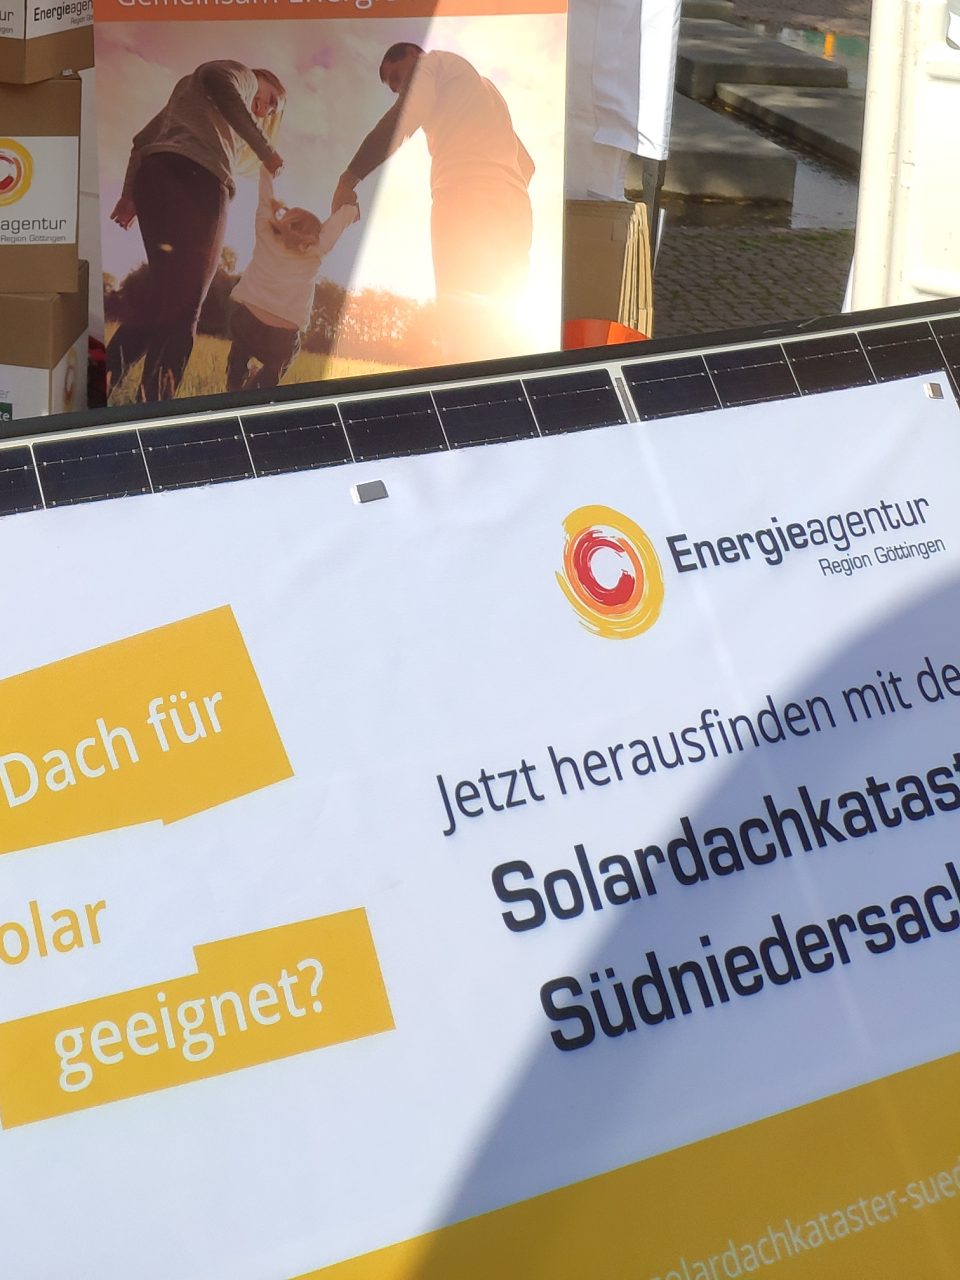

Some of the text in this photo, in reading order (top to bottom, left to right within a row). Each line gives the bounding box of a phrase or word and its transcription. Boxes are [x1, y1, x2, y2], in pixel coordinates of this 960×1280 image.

[0, 234, 66, 243] Region Göttingen
[666, 496, 930, 574] Energieagentur
[818, 535, 946, 577] Region Göttingen
[146, 689, 225, 753] für
[435, 758, 544, 837] Jetzt
[547, 694, 837, 796] herausfinden
[841, 670, 912, 723] mit
[491, 752, 960, 932] Solardachkatas
[53, 957, 326, 1093] geeignet?
